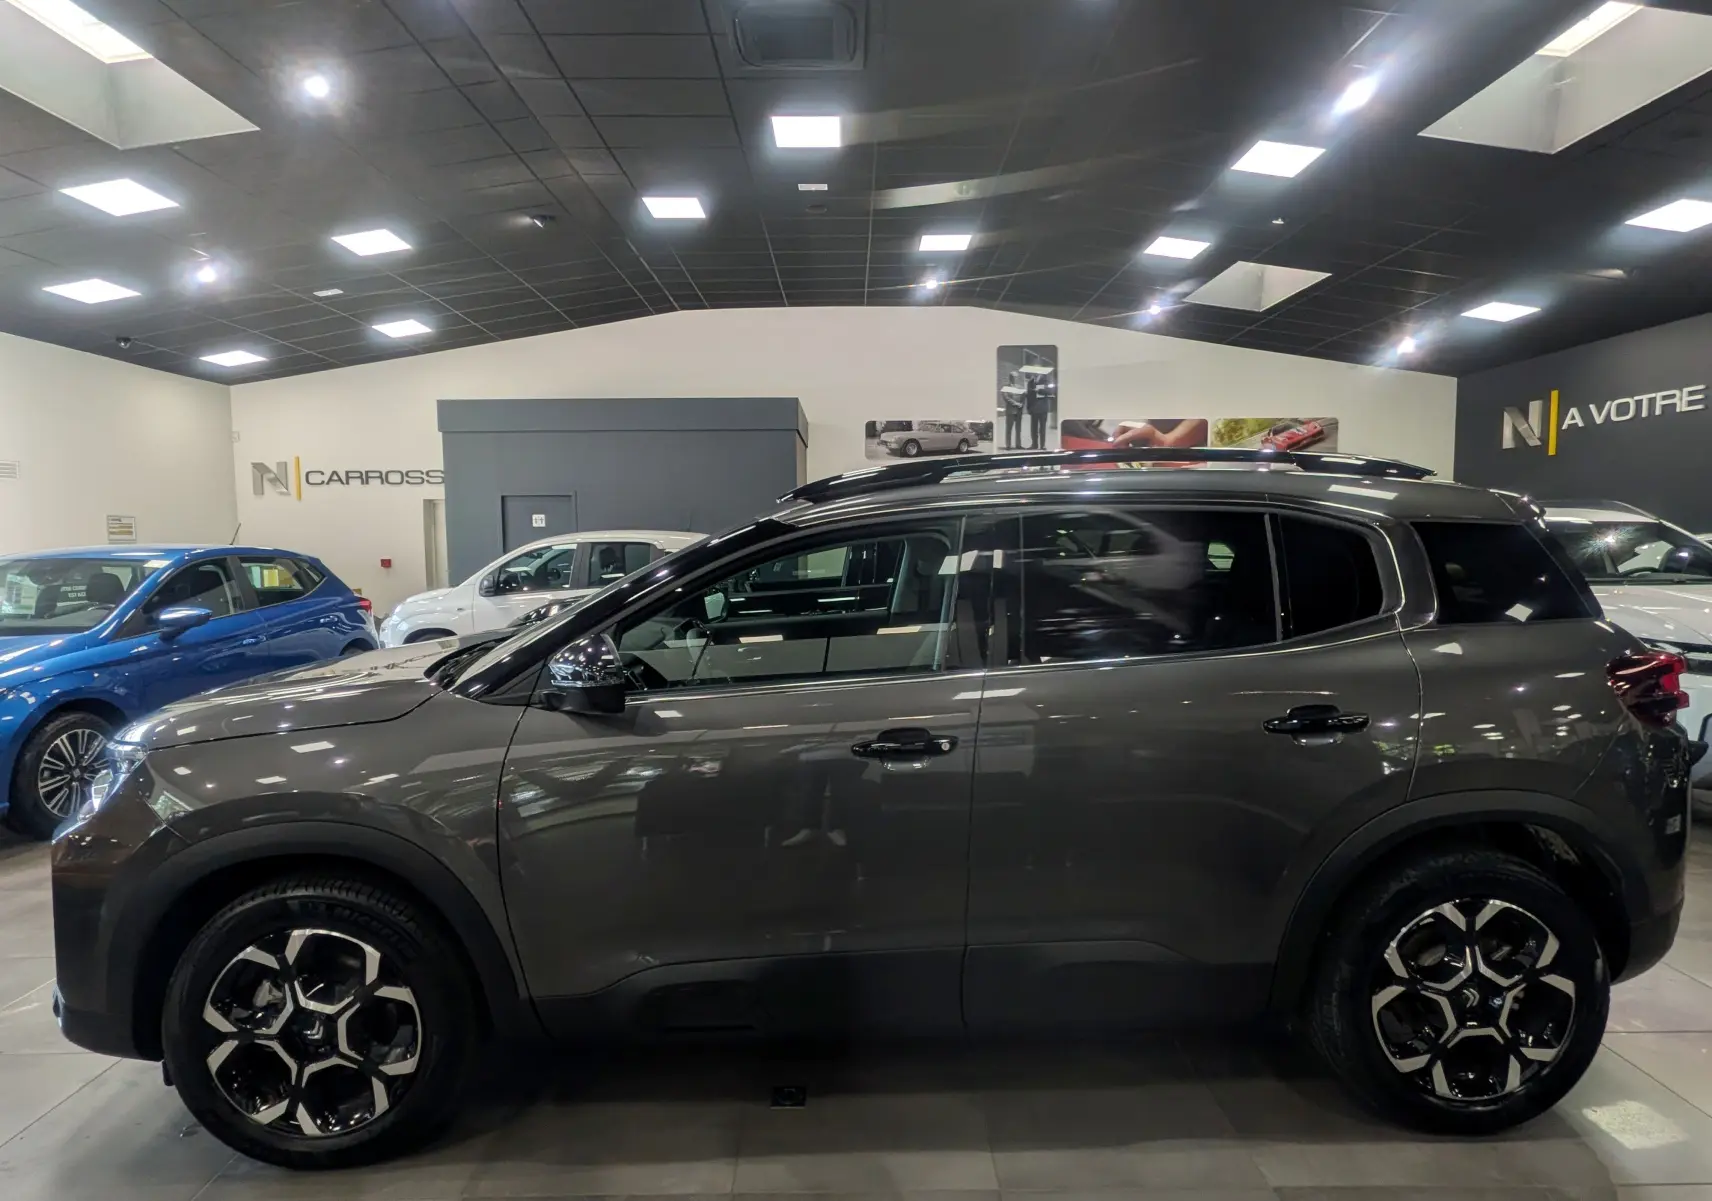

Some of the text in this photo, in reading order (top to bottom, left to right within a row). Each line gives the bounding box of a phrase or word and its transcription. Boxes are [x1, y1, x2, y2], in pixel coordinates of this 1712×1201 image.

[1561, 384, 1707, 430] A VOTRE
[305, 470, 445, 486] CARROSS
